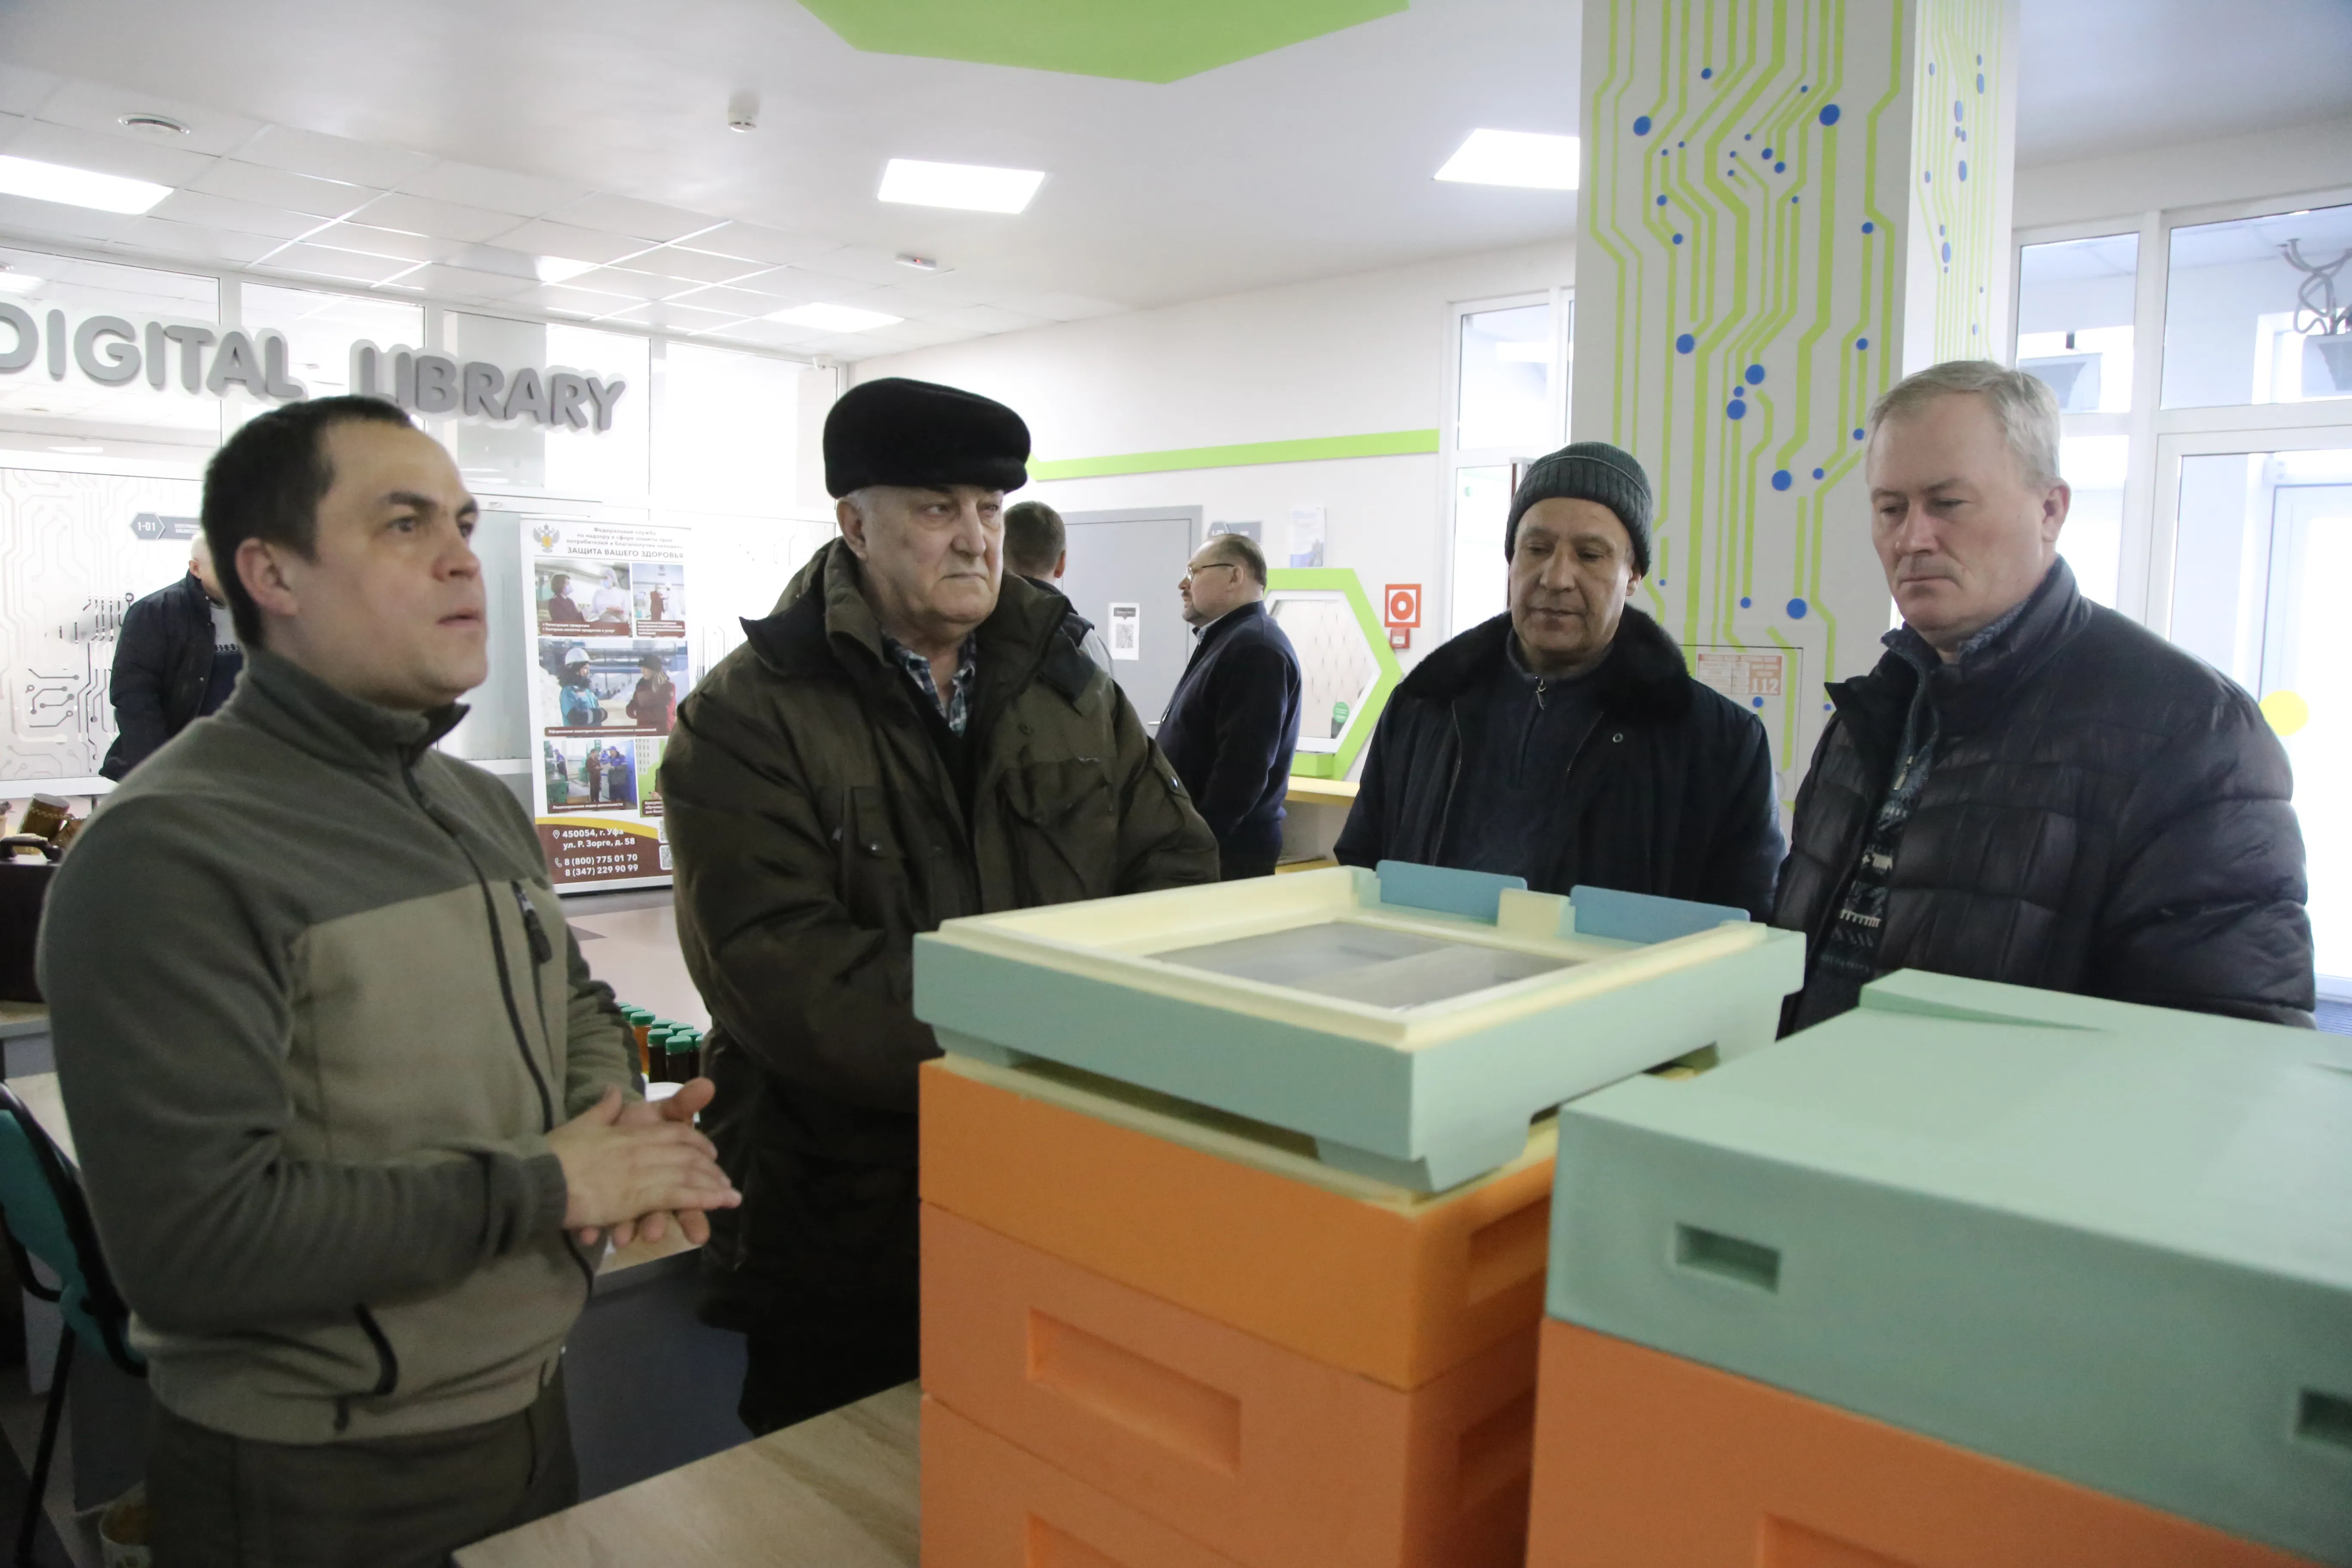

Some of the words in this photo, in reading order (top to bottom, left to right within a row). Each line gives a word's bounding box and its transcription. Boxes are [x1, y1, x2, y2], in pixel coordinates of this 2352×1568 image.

[0, 303, 305, 398] DIGITAL
[360, 347, 626, 430] LIBRARY
[138, 521, 156, 531] 1-01
[1751, 678, 1779, 693] 112
[562, 829, 598, 838] 450054,
[607, 827, 624, 837] Уфа
[563, 842, 576, 851] ул.
[586, 839, 613, 848] Зорге,
[572, 857, 594, 866] (800)
[596, 855, 612, 864] 775
[573, 867, 595, 877] (347)
